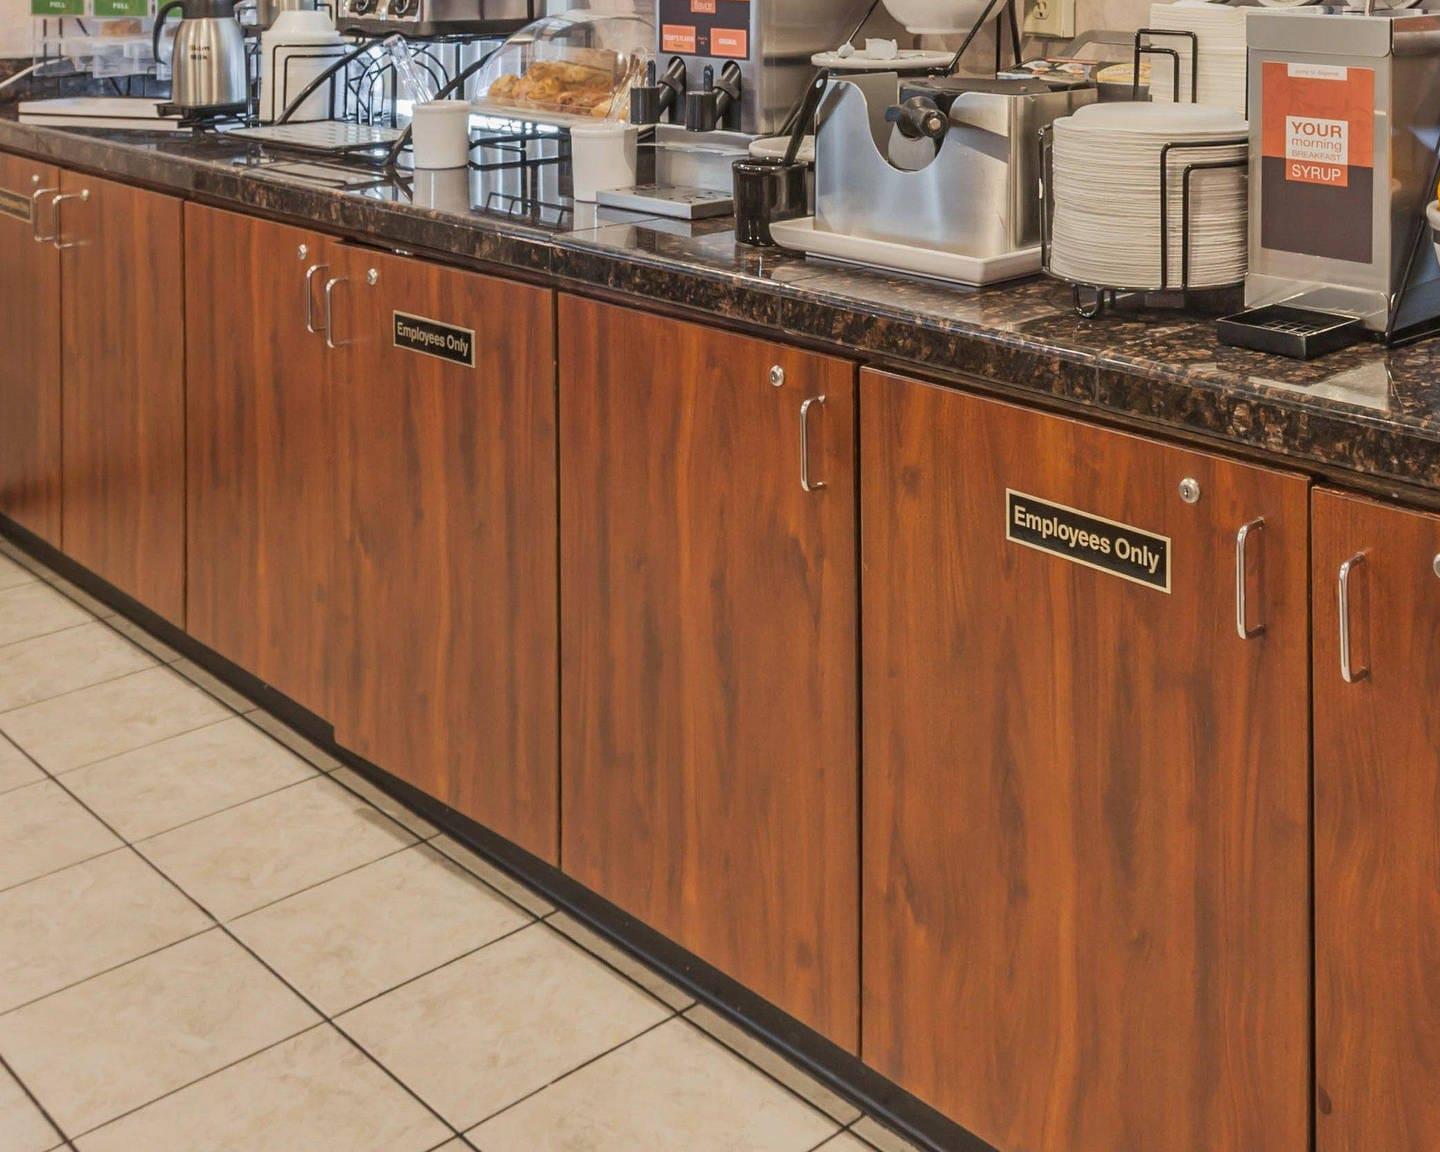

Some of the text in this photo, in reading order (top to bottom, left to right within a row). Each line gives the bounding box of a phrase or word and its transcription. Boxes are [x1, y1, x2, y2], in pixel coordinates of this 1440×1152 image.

[1291, 120, 1343, 139] YOUR
[1291, 137, 1343, 153] morning
[1291, 149, 1341, 161] BREAKFAST
[1291, 163, 1342, 182] SYRUP
[397, 321, 469, 357] Employees Only
[1014, 504, 1160, 574] Employees Only
